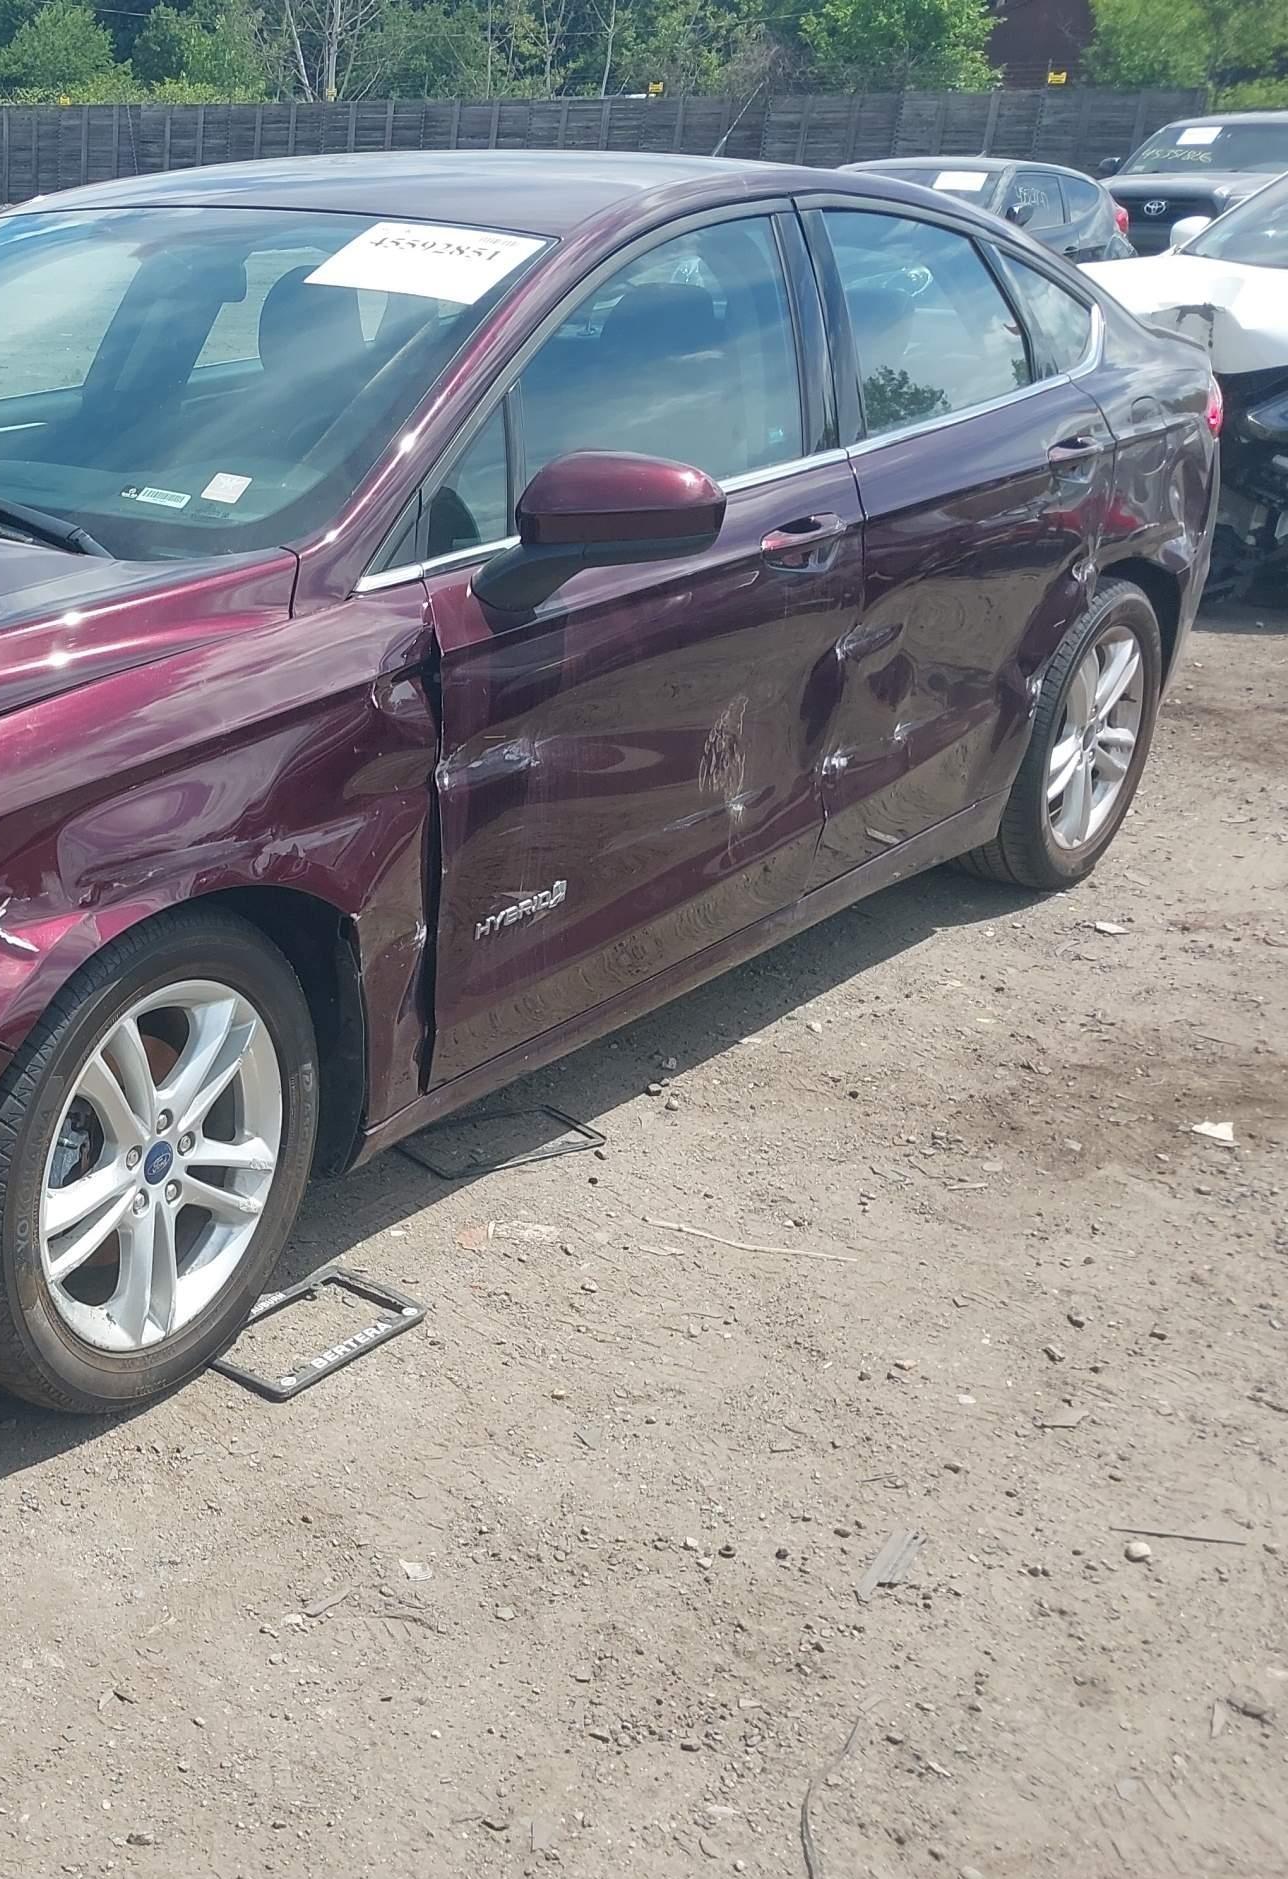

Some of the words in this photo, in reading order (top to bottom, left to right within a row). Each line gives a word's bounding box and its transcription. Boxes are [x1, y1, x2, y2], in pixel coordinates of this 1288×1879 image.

[370, 237, 501, 261] 45592851
[474, 890, 552, 941] HYBRID
[250, 1291, 287, 1315] AUBURN
[310, 1321, 393, 1370] BERTERA
